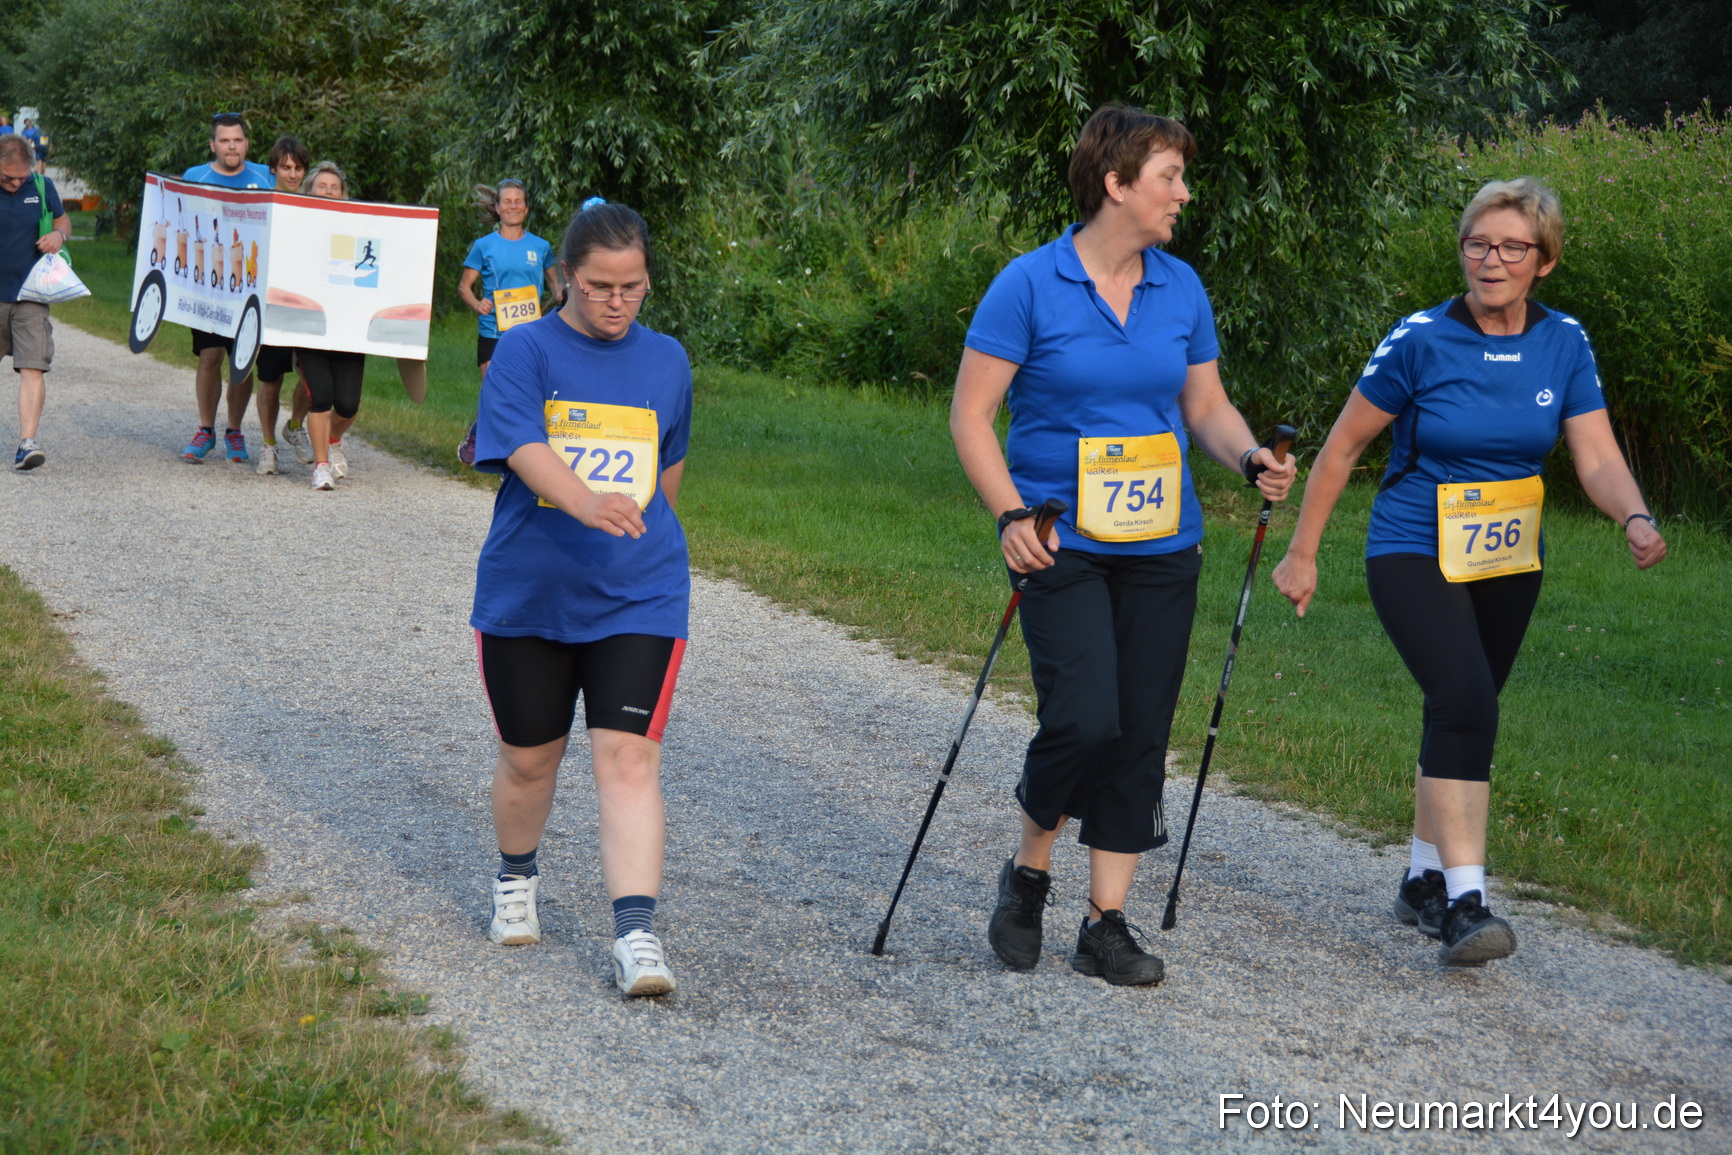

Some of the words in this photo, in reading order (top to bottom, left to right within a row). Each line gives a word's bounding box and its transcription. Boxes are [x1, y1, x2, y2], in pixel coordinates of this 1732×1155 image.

[246, 208, 267, 221] Neumarkt
[501, 302, 536, 319] 1289
[1483, 351, 1521, 362] hummel
[560, 419, 602, 430] firmenlauf
[547, 430, 581, 441] walken
[1097, 453, 1139, 463] firmenlauf
[564, 445, 635, 484] 722
[1086, 466, 1119, 476] walken
[1103, 476, 1164, 513] 754
[1456, 498, 1496, 508] firmenlauf
[1445, 510, 1477, 520] walken
[1113, 519, 1133, 527] Gerda
[1134, 518, 1153, 526] Kirsch
[1462, 518, 1522, 554] 756
[1494, 554, 1513, 564] Kirsch
